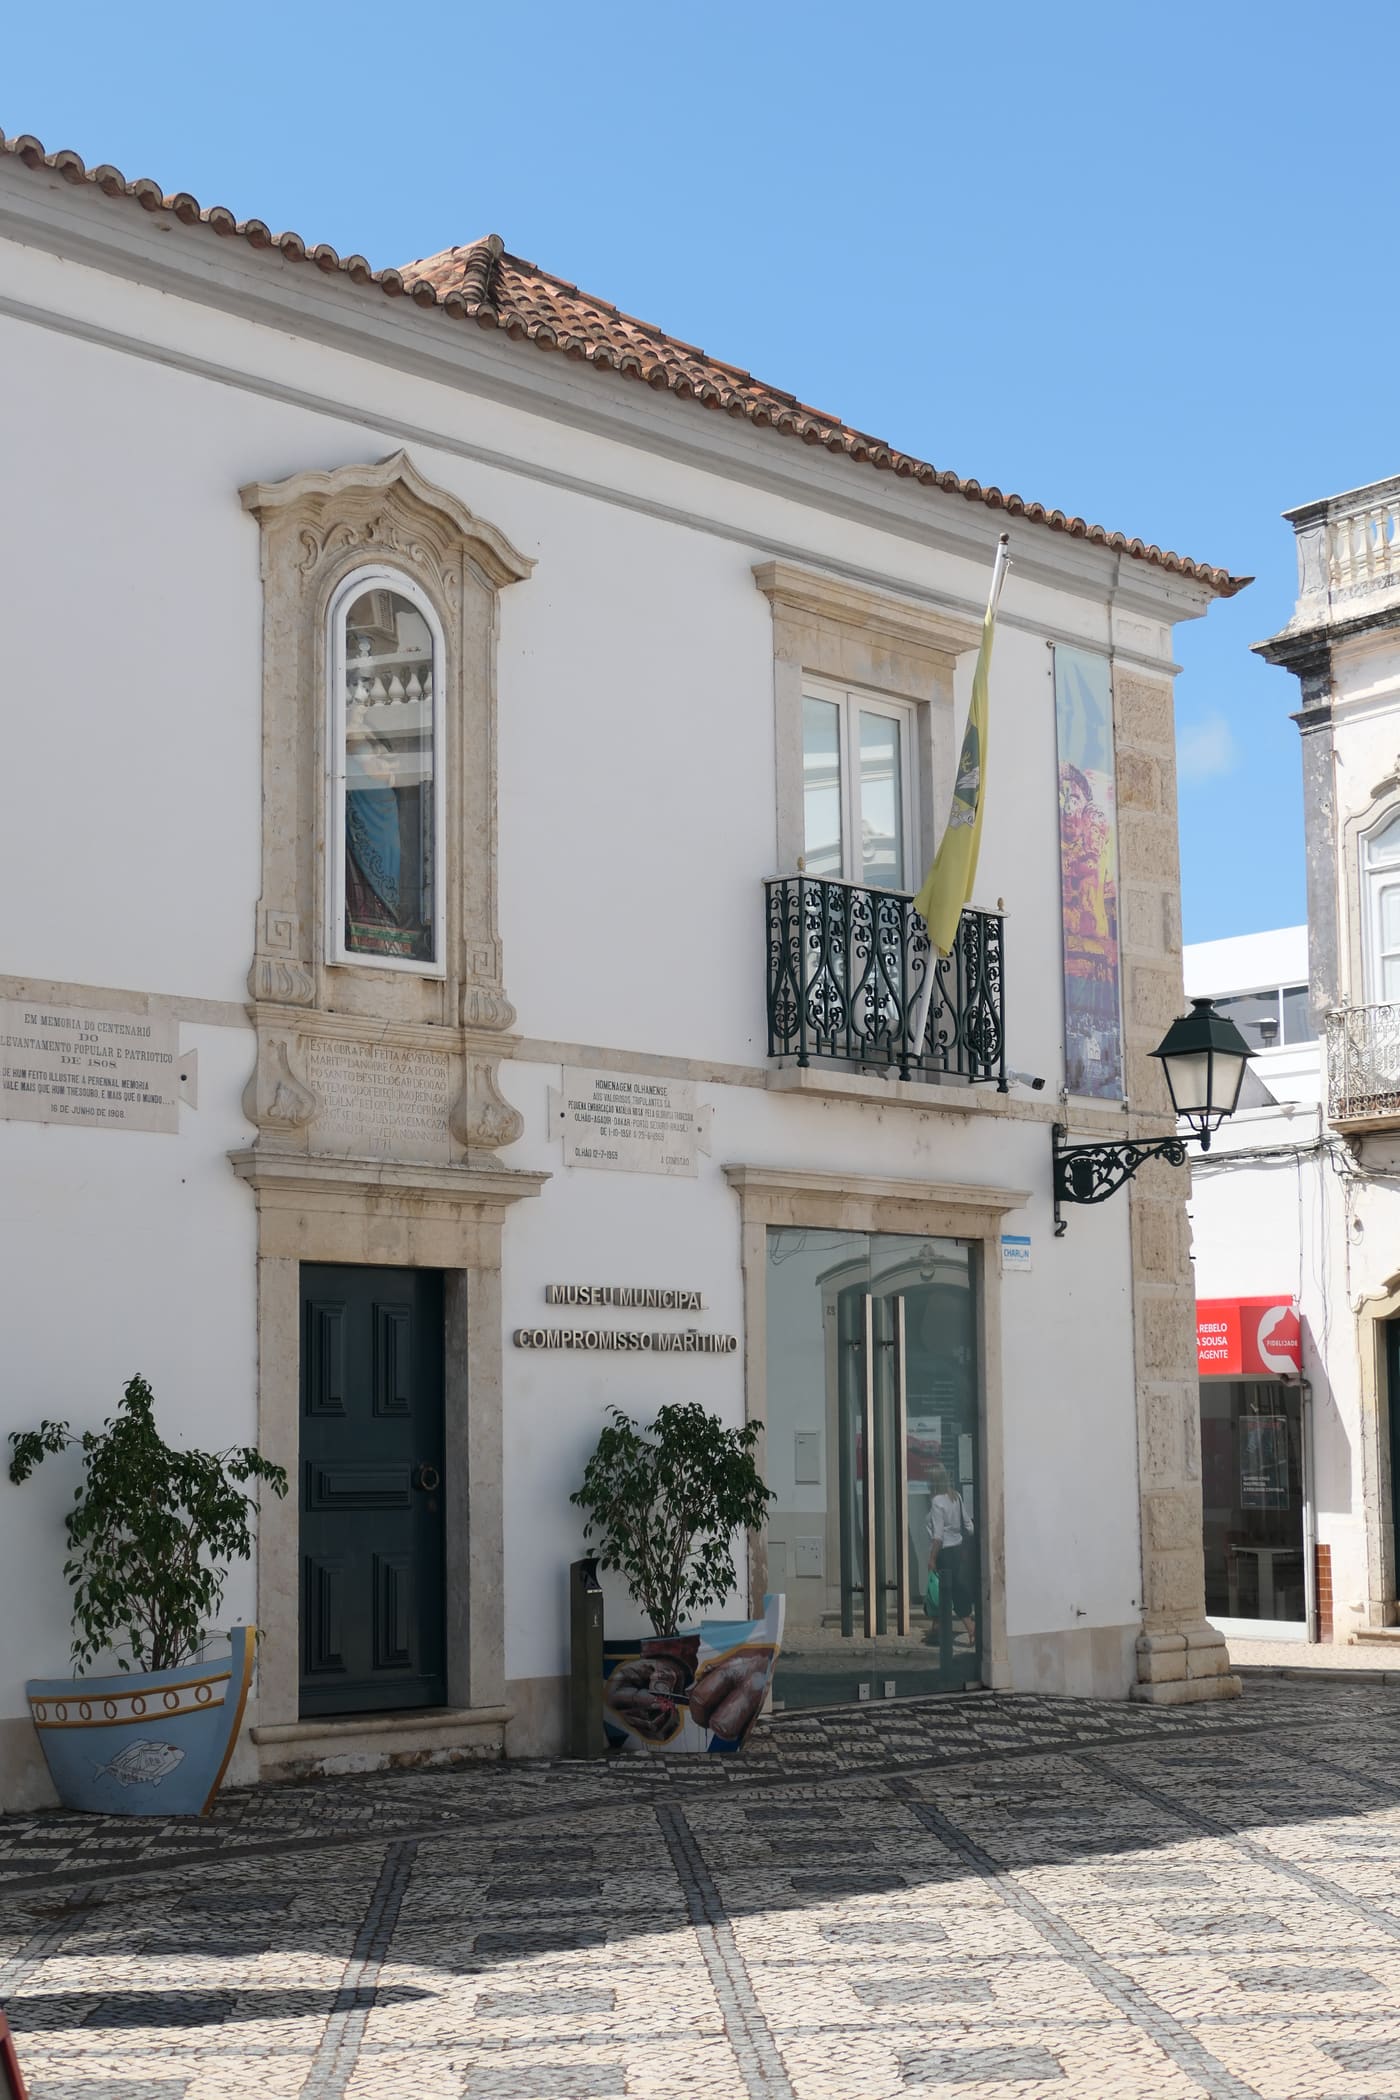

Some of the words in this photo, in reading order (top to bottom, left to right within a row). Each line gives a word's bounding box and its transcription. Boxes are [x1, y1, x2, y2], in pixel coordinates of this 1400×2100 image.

[24, 1013, 37, 1025] EM
[40, 1015, 81, 1030] MEMORIA
[84, 1020, 95, 1031] DO
[97, 1021, 151, 1037] CENTENARIO
[79, 1032, 99, 1042] DO
[0, 1035, 72, 1054] LEVANTAMENTO
[74, 1043, 114, 1058] POPULAR
[116, 1048, 122, 1058] E
[124, 1049, 173, 1064] PATRIOTICO
[61, 1055, 81, 1065] DE
[88, 1058, 118, 1069] 1808
[13, 1068, 27, 1078] HUM
[28, 1070, 48, 1081] FEITO
[49, 1071, 81, 1084] ILLUSTRE
[82, 1075, 86, 1084] A
[87, 1075, 119, 1088] PERENNAL
[121, 1078, 149, 1090] MEMORIA
[3, 1080, 19, 1091] VALE
[20, 1081, 36, 1092] MAIS
[37, 1083, 50, 1094] QUE
[52, 1085, 65, 1095] HUM
[101, 1089, 105, 1098] E
[107, 1090, 122, 1100] MAIS
[123, 1091, 136, 1103] QUE
[137, 1092, 142, 1102] O
[595, 1080, 632, 1093] HOMENAGEM
[633, 1084, 668, 1097] OLHANENSE
[51, 1104, 58, 1113] 16
[59, 1104, 70, 1114] DE
[71, 1106, 95, 1116] JUNHO
[97, 1108, 106, 1117] DE
[547, 1285, 614, 1306] MUSEU
[615, 1288, 709, 1310] MUNICIPAL
[1199, 1323, 1228, 1333] REBELO
[514, 1329, 652, 1350] COMPROMISSO
[1201, 1336, 1228, 1346] SOUSA
[1199, 1349, 1229, 1360] AGENTE
